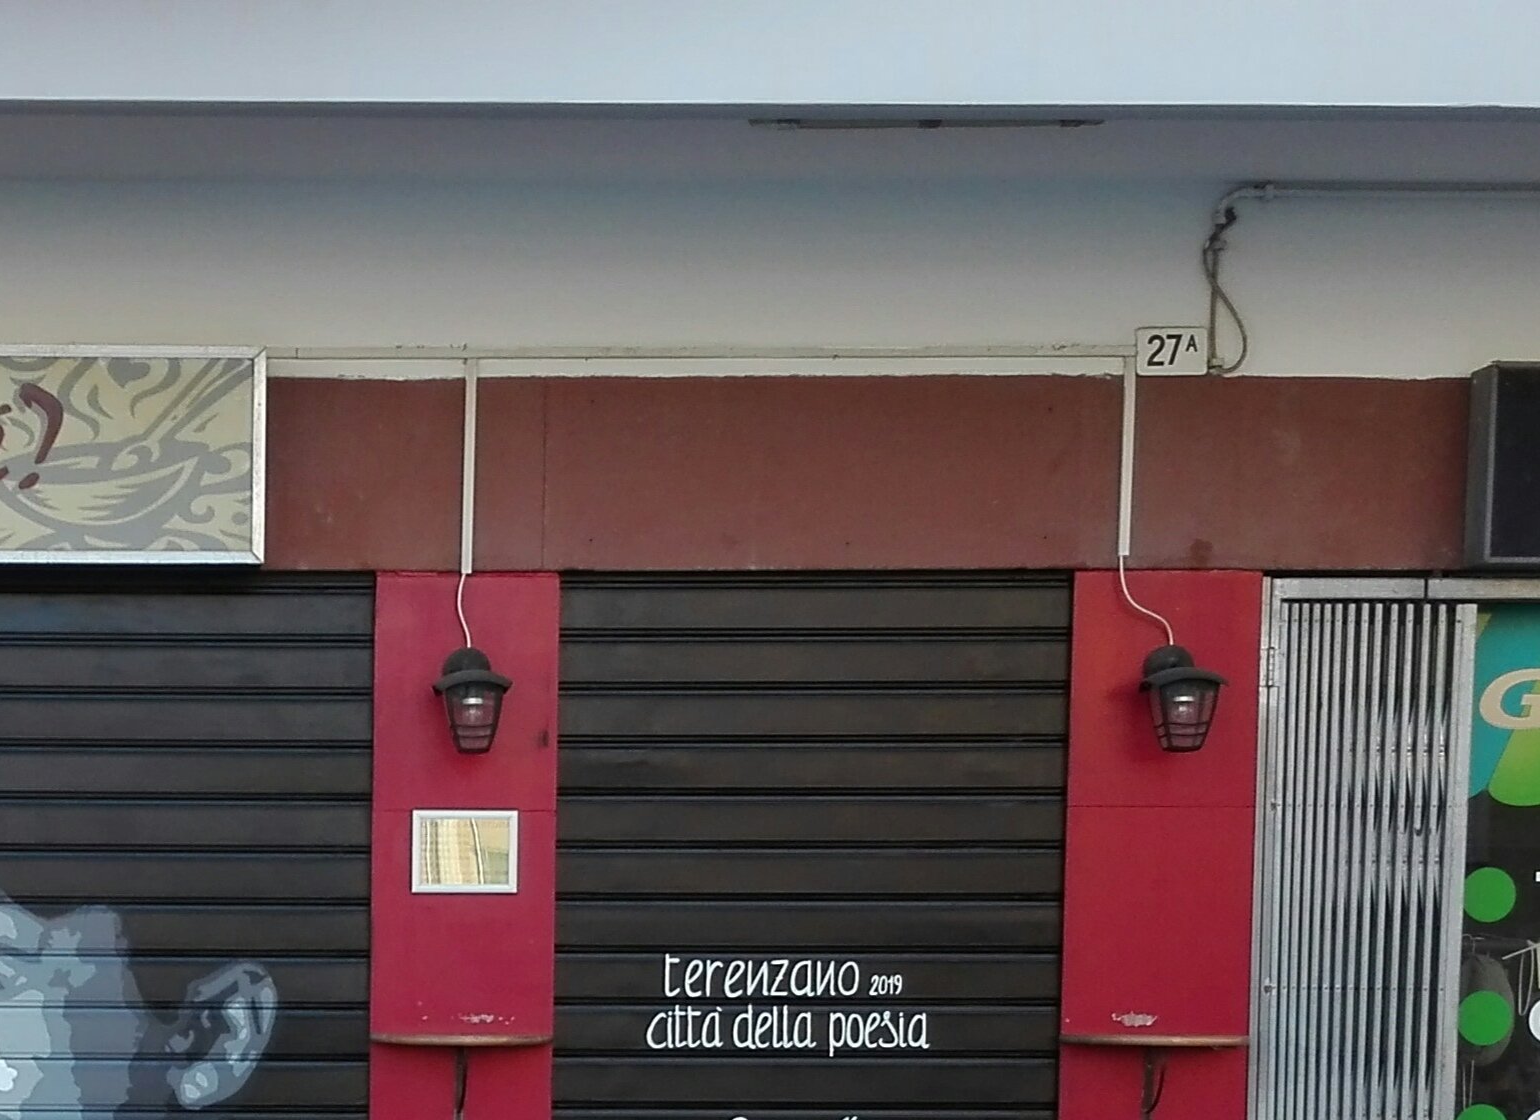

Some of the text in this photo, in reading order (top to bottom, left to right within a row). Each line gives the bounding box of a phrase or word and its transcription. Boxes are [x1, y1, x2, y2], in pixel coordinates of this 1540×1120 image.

[663, 952, 904, 999] terenzano 2019
[645, 1003, 931, 1058] città della poesia
